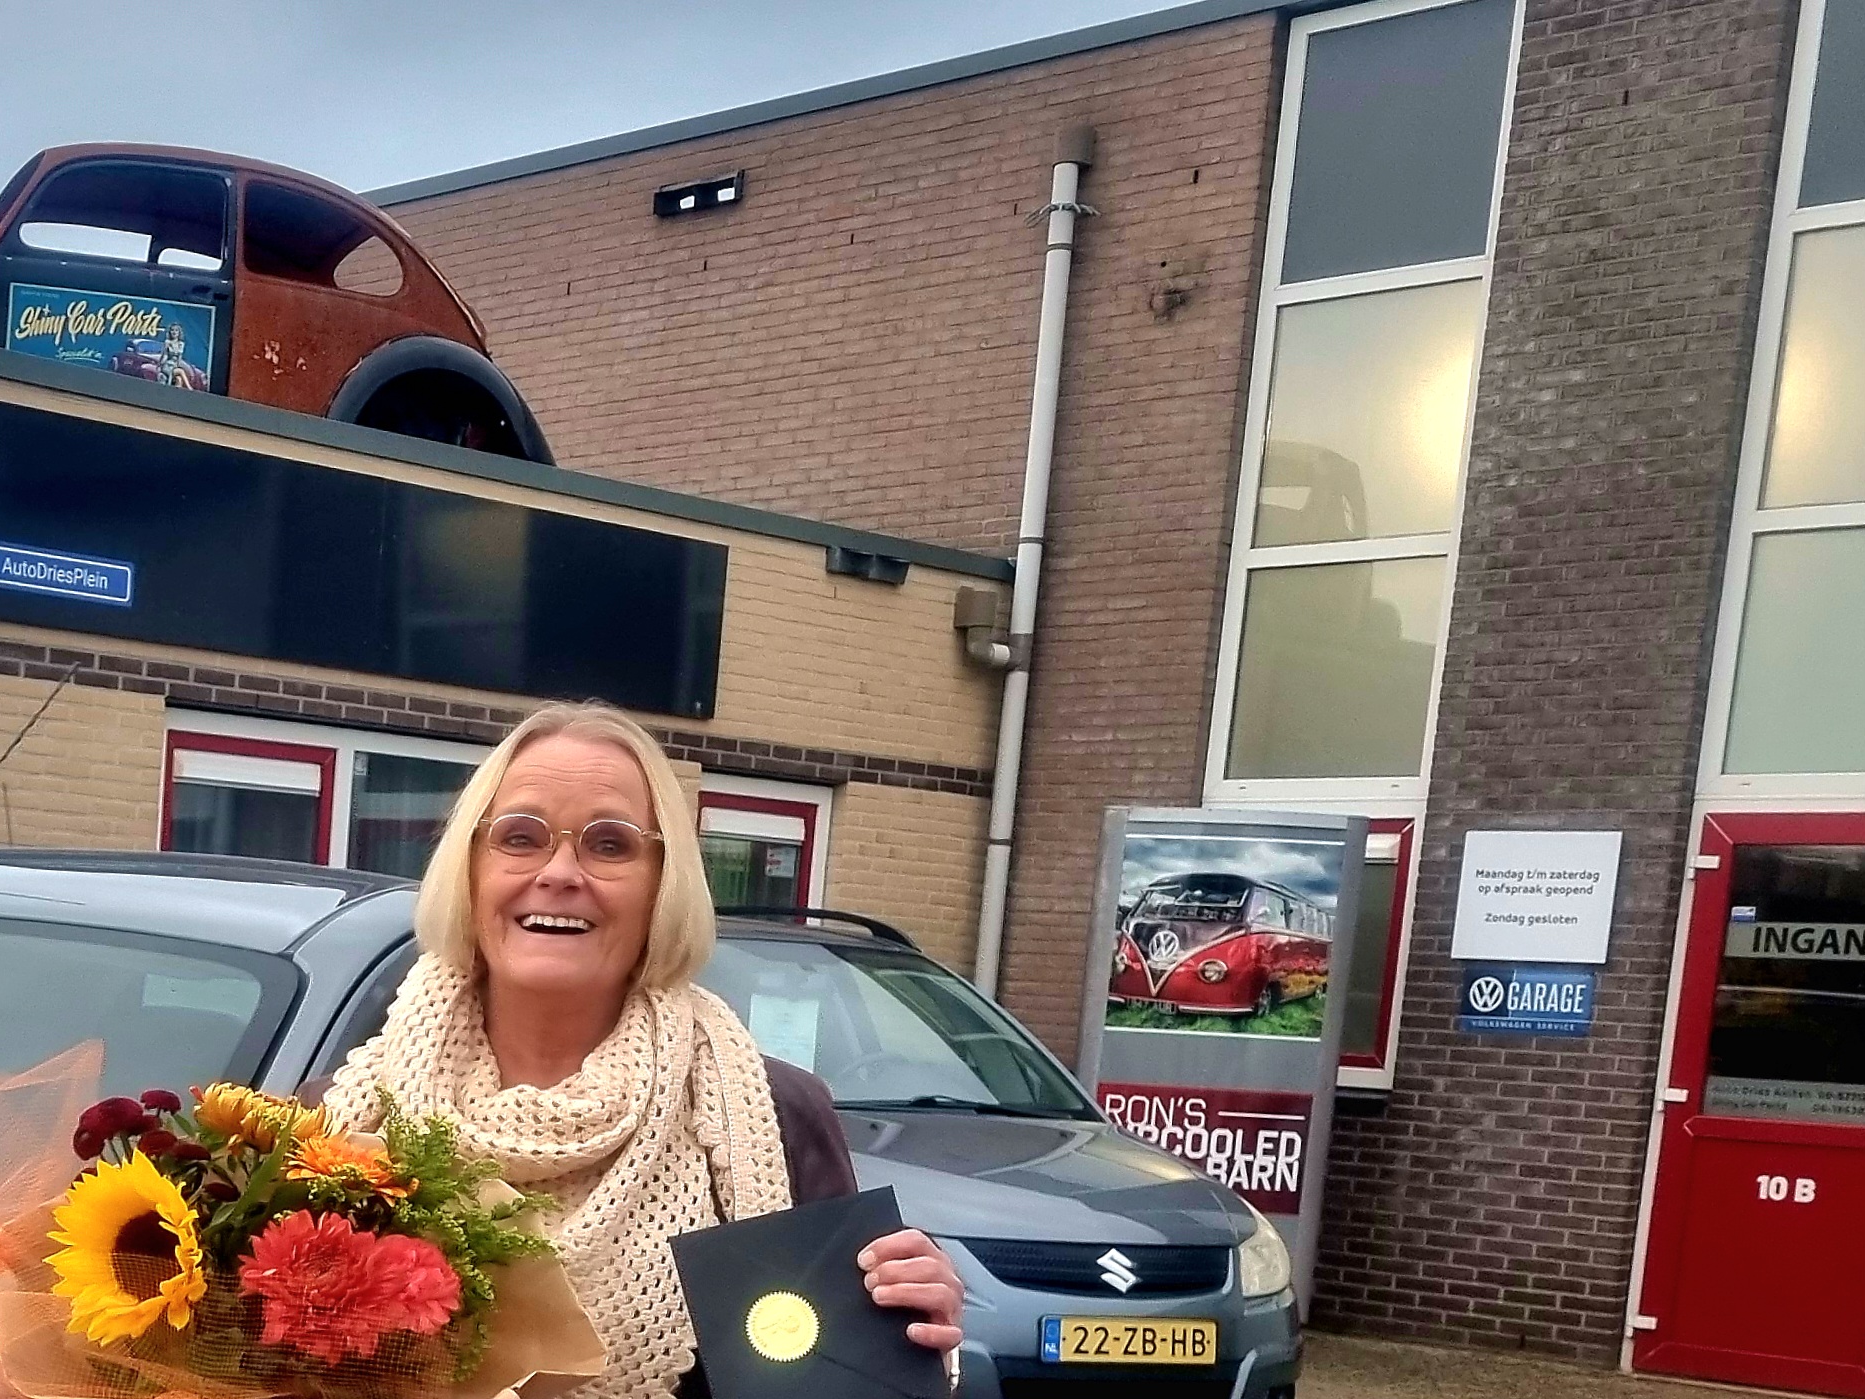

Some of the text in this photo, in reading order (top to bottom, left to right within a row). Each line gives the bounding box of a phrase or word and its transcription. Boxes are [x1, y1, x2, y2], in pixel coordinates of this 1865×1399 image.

[15, 300, 165, 346] Shiny Car Parts
[1, 556, 108, 590] AutoDriesPlein
[1475, 868, 1601, 883] Maandag t/m zaterdag
[1478, 883, 1594, 897] op afspraak geopend
[1484, 912, 1578, 927] Zondag gesloten
[1507, 981, 1587, 1013] GARAGE
[1104, 1093, 1207, 1130] RON'S
[1206, 1156, 1300, 1192] BARN
[1756, 1174, 1817, 1203] 10 B
[1072, 1325, 1207, 1357] 22-ZB-HB
